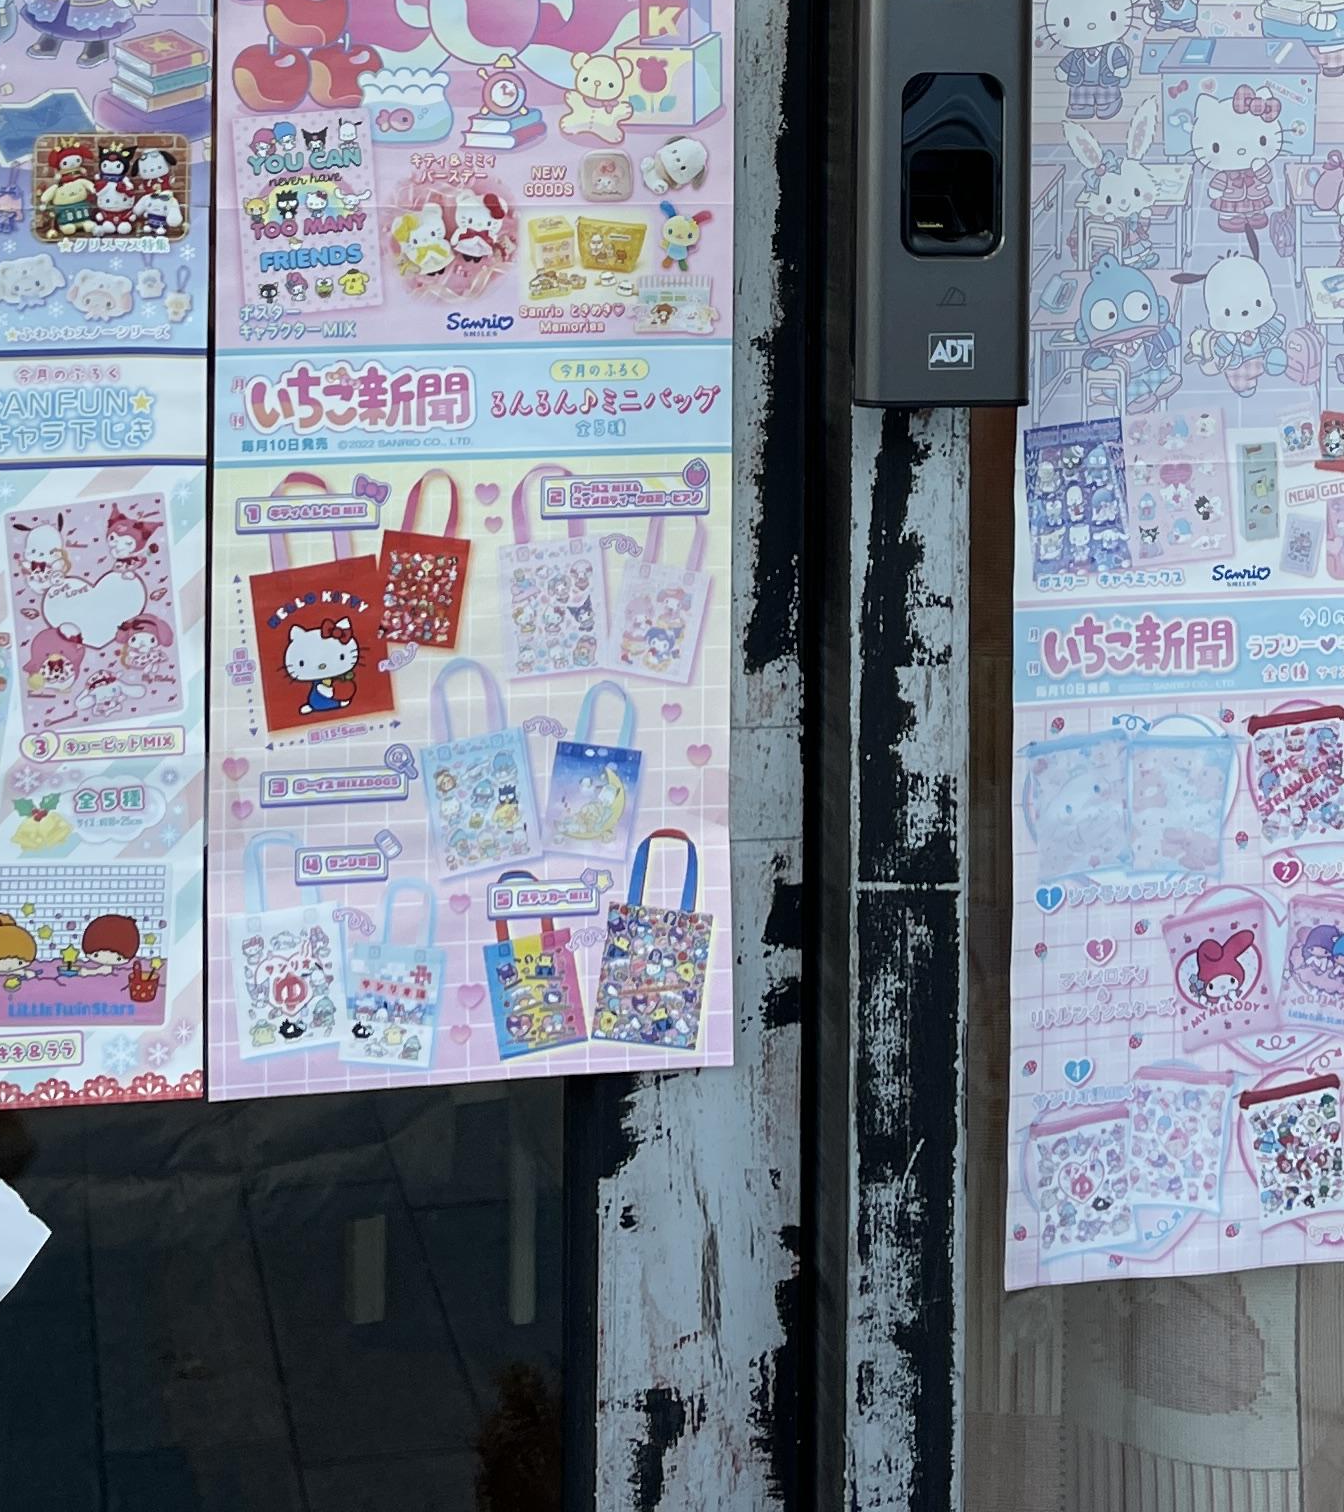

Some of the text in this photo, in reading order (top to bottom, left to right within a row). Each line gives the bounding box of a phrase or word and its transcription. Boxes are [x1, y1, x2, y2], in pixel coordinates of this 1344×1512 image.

[649, 6, 682, 36] K
[247, 146, 362, 176] YOU CAN
[268, 172, 343, 188] never have
[419, 170, 489, 184] バースデー
[530, 166, 567, 181] NEW
[524, 183, 574, 198] GOODS
[250, 212, 367, 240] TOO MANY
[259, 242, 364, 273] FRIENDS
[239, 304, 302, 322] ポスター
[446, 311, 515, 331] Sanrio
[519, 304, 564, 319] Sanrio
[239, 321, 357, 339] キャラクターMIX
[539, 320, 606, 335] Memories
[929, 338, 975, 365] ADT
[18, 368, 121, 384] 今月のふろく
[560, 363, 640, 378] 今月のふろく
[250, 365, 471, 429] いちご新聞
[241, 437, 422, 453] 毎月10日発売 SANRIO
[1286, 489, 1318, 507] NEW
[1038, 563, 1271, 588] ポスター キャラミックス Sanrio
[1043, 615, 1234, 675] いちご新聞
[1261, 664, 1310, 683] 全5種
[33, 738, 48, 757] 3
[1270, 754, 1300, 776] THE
[1258, 750, 1344, 818] STRAWBERRY
[76, 788, 143, 812] 全5種
[1299, 782, 1340, 813] NEWS
[1281, 864, 1293, 880] 2
[1060, 965, 1149, 988] マイメロディ
[1030, 998, 1178, 1030] リトルツインスターズ
[1208, 1000, 1261, 1020] MELODY
